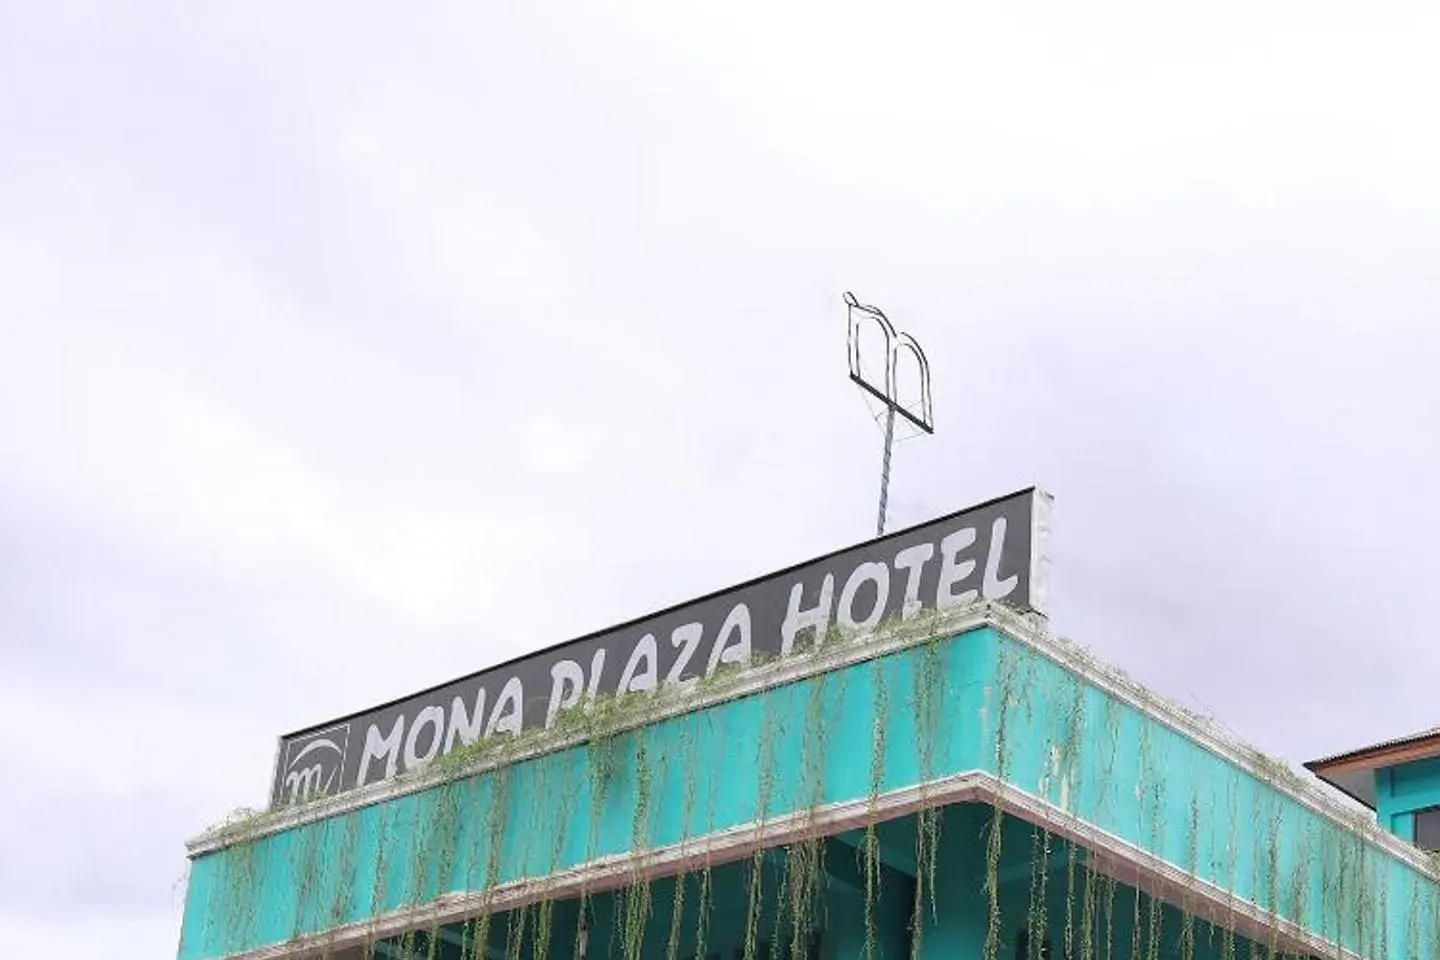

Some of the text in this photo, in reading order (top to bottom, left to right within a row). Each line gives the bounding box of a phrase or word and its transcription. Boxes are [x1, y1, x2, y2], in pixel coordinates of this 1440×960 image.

[357, 517, 1018, 787] MONA PLAZA HOTEL
